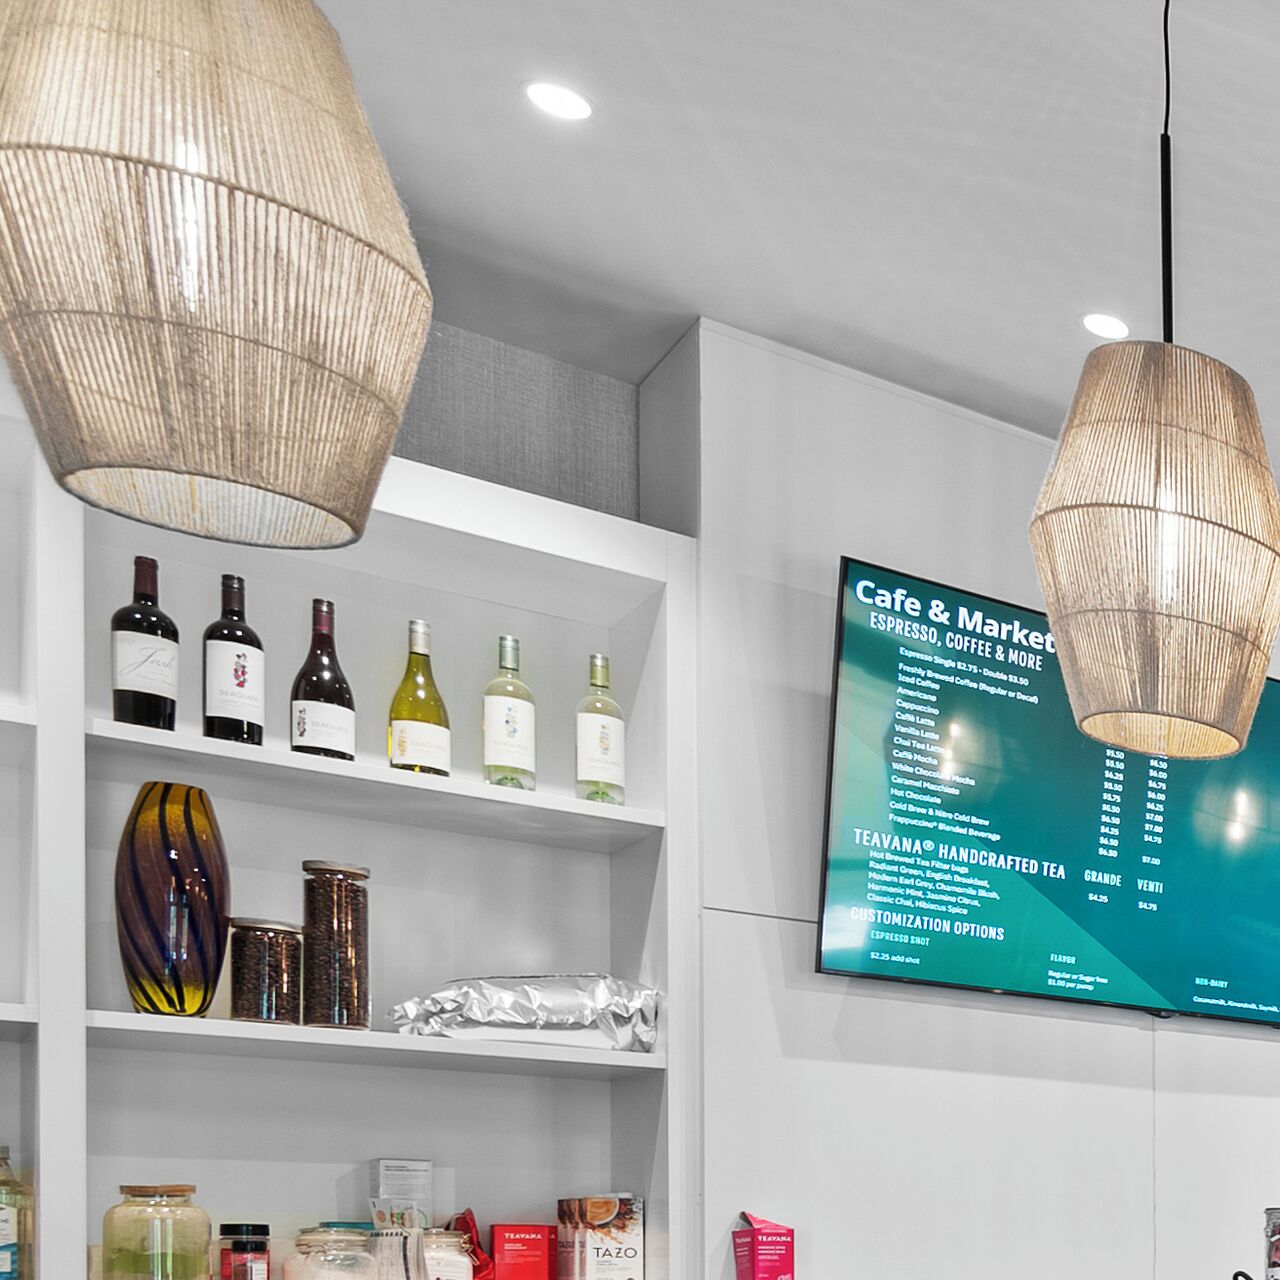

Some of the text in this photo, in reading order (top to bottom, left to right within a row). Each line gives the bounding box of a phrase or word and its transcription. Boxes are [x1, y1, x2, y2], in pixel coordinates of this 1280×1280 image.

[856, 580, 1056, 653] Cafe & Market
[870, 612, 1043, 671] ESPRESSO, COFFEE & MORE
[900, 647, 933, 663] Espresso
[933, 654, 956, 669] Single
[983, 667, 1007, 681] Double
[898, 662, 926, 678] Freshly
[954, 676, 978, 690] Coffee
[1008, 690, 1016, 698] or
[898, 673, 941, 691] Iced Coffee
[896, 686, 937, 702] Americano
[896, 698, 940, 716] Cappuccino
[893, 724, 920, 737] Vanilla
[893, 736, 911, 747] Chai
[891, 762, 914, 774] White
[891, 775, 922, 789] Caramel
[890, 787, 942, 804] Hot Chocolate
[889, 801, 907, 812] Cold
[908, 804, 927, 816] Brew
[953, 813, 970, 823] Cold
[970, 815, 990, 827] Brew
[938, 822, 1001, 842] Blended Beverage
[870, 850, 885, 860] Hot
[885, 853, 915, 866] Brewed
[916, 858, 930, 868] Tea
[938, 843, 1038, 874] HANDCRAFTED
[1042, 862, 1066, 880] TEA
[868, 871, 898, 883] Modern
[899, 877, 915, 887] Earl
[869, 860, 899, 873] Radiant
[925, 870, 953, 882] English
[1084, 869, 1164, 894] GRANDE VENTI
[866, 892, 894, 905] Classic
[947, 905, 969, 916] Spice
[850, 907, 1005, 942] CUSTOMIZATION OPTIONS
[870, 930, 909, 945] ESPRESSO
[870, 951, 921, 965] $2.25 add shot
[593, 1247, 637, 1259] TAZO
